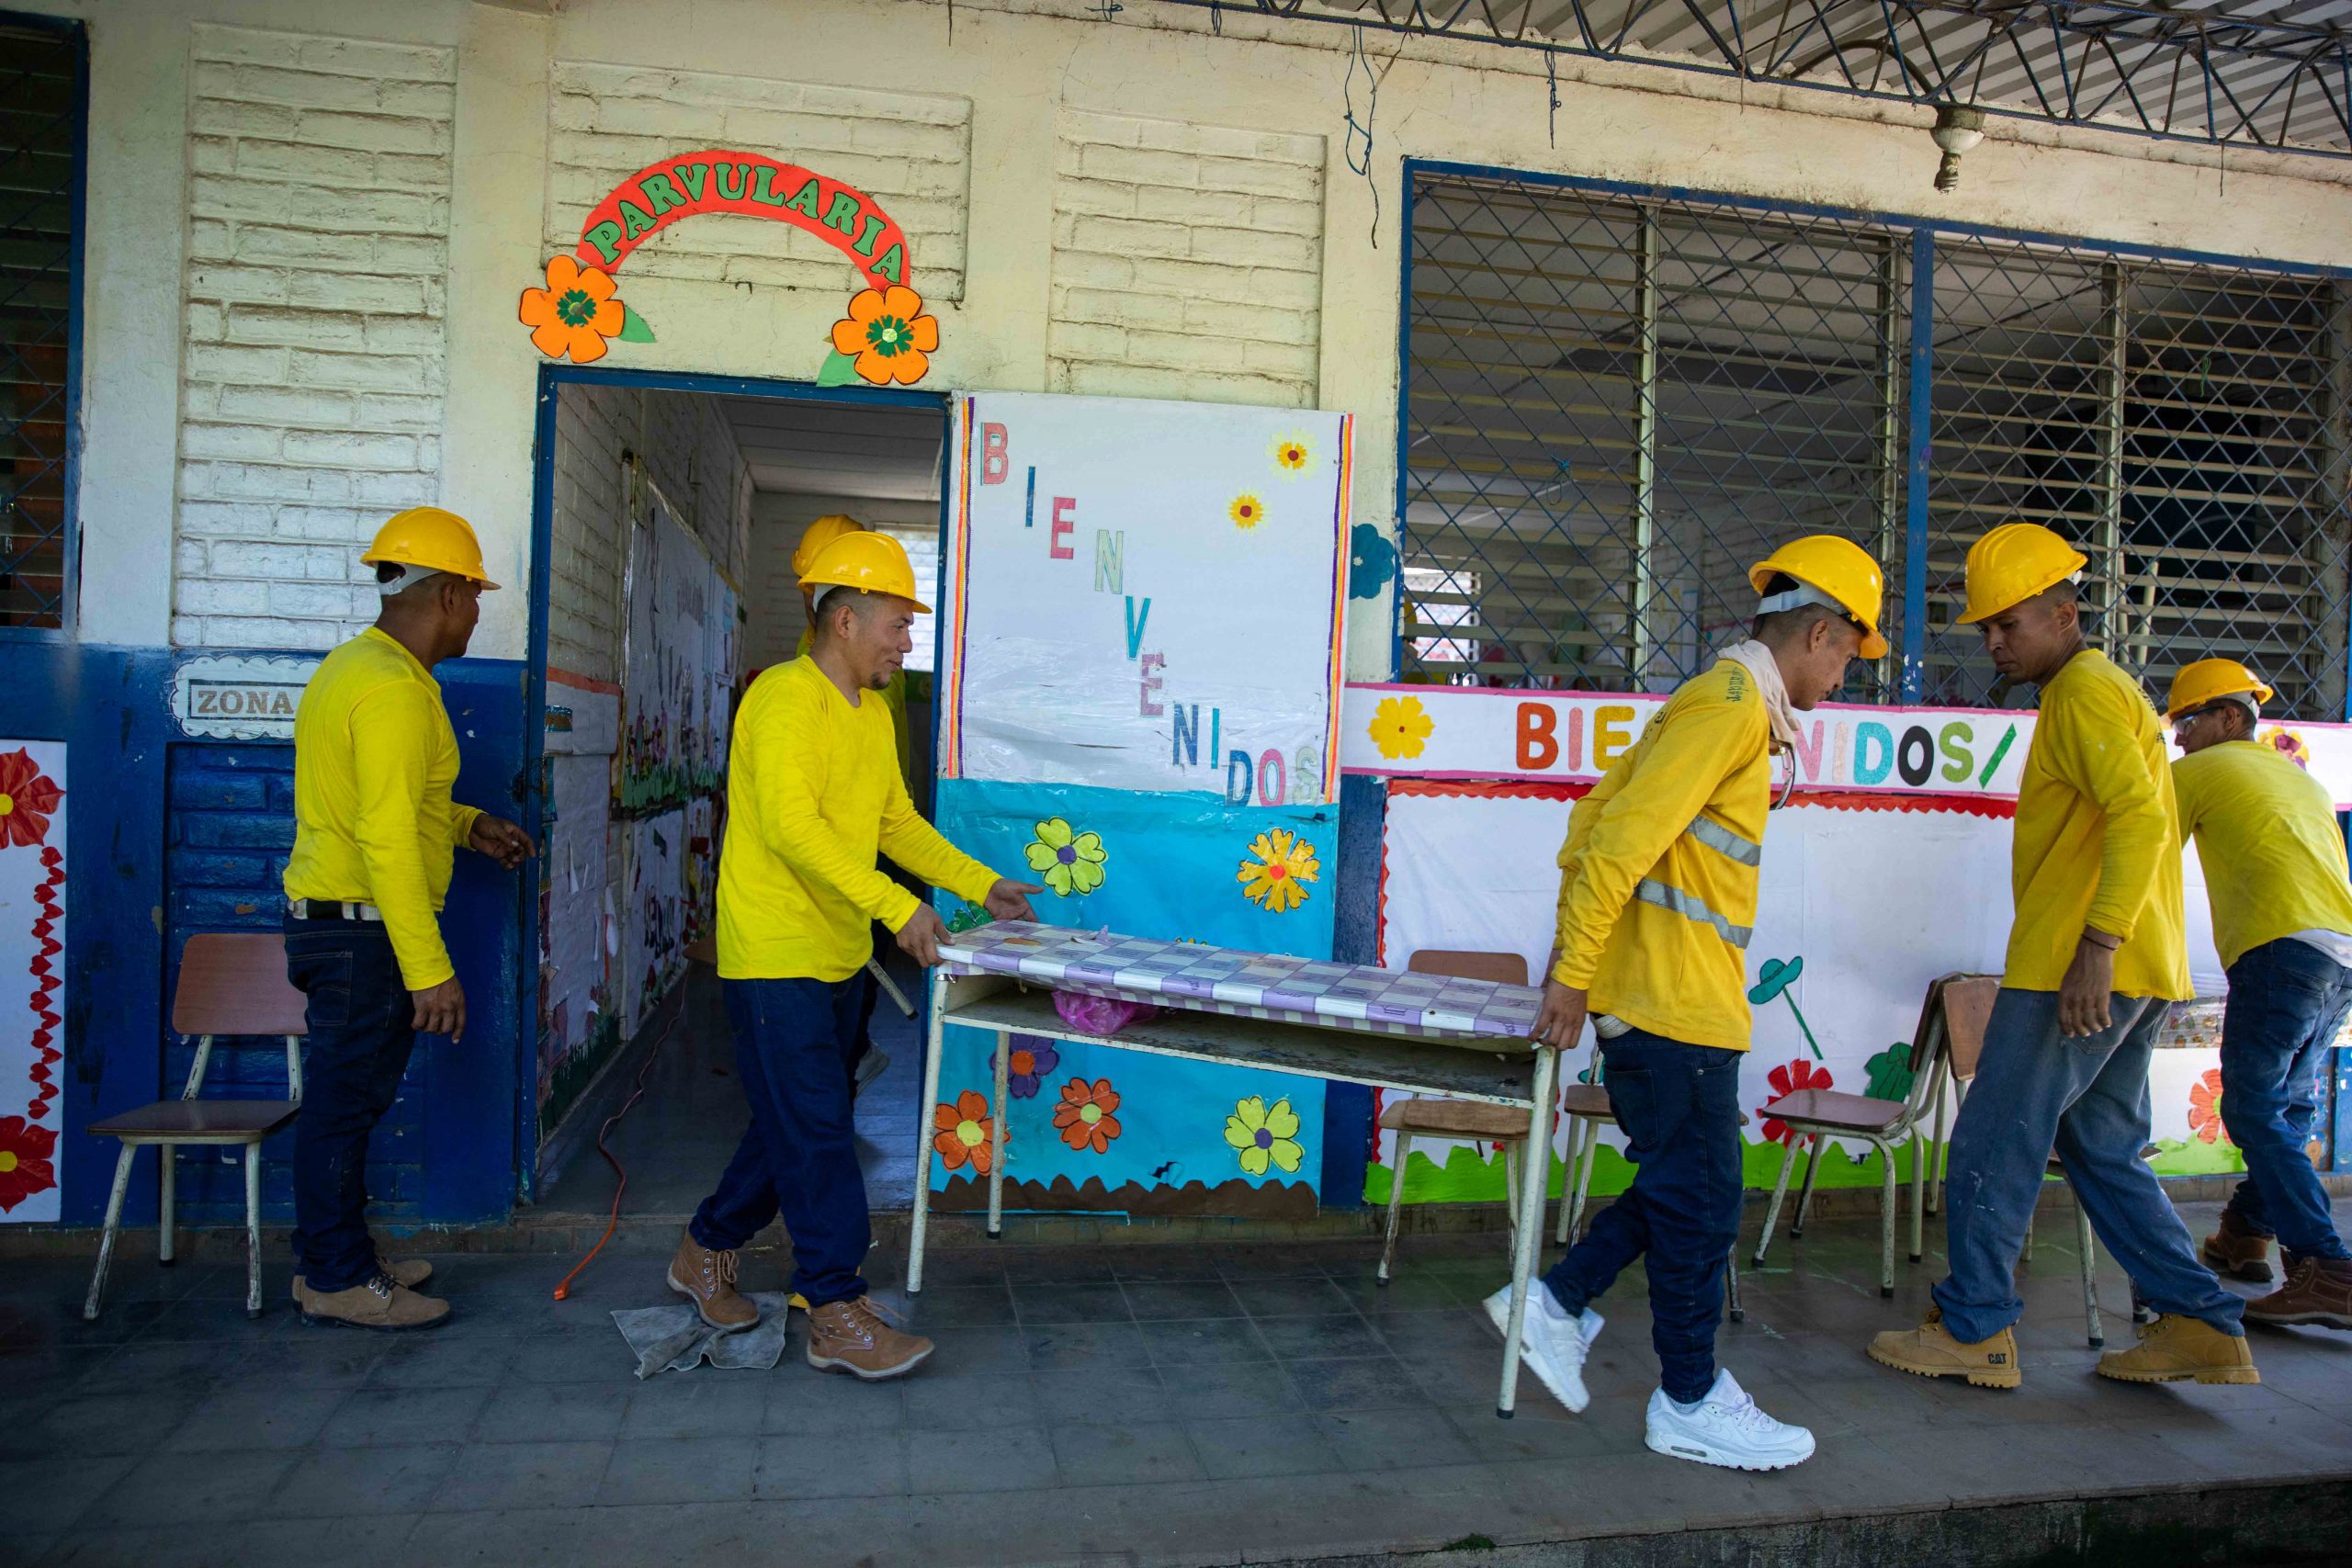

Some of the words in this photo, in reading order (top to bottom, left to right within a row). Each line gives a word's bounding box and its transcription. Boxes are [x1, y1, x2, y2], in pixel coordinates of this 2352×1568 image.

[584, 162, 903, 284] PARVULARIA
[980, 422, 1318, 807] BIENVENIDOS
[198, 690, 295, 715] ZONA
[1987, 1352, 2007, 1365] CAT
